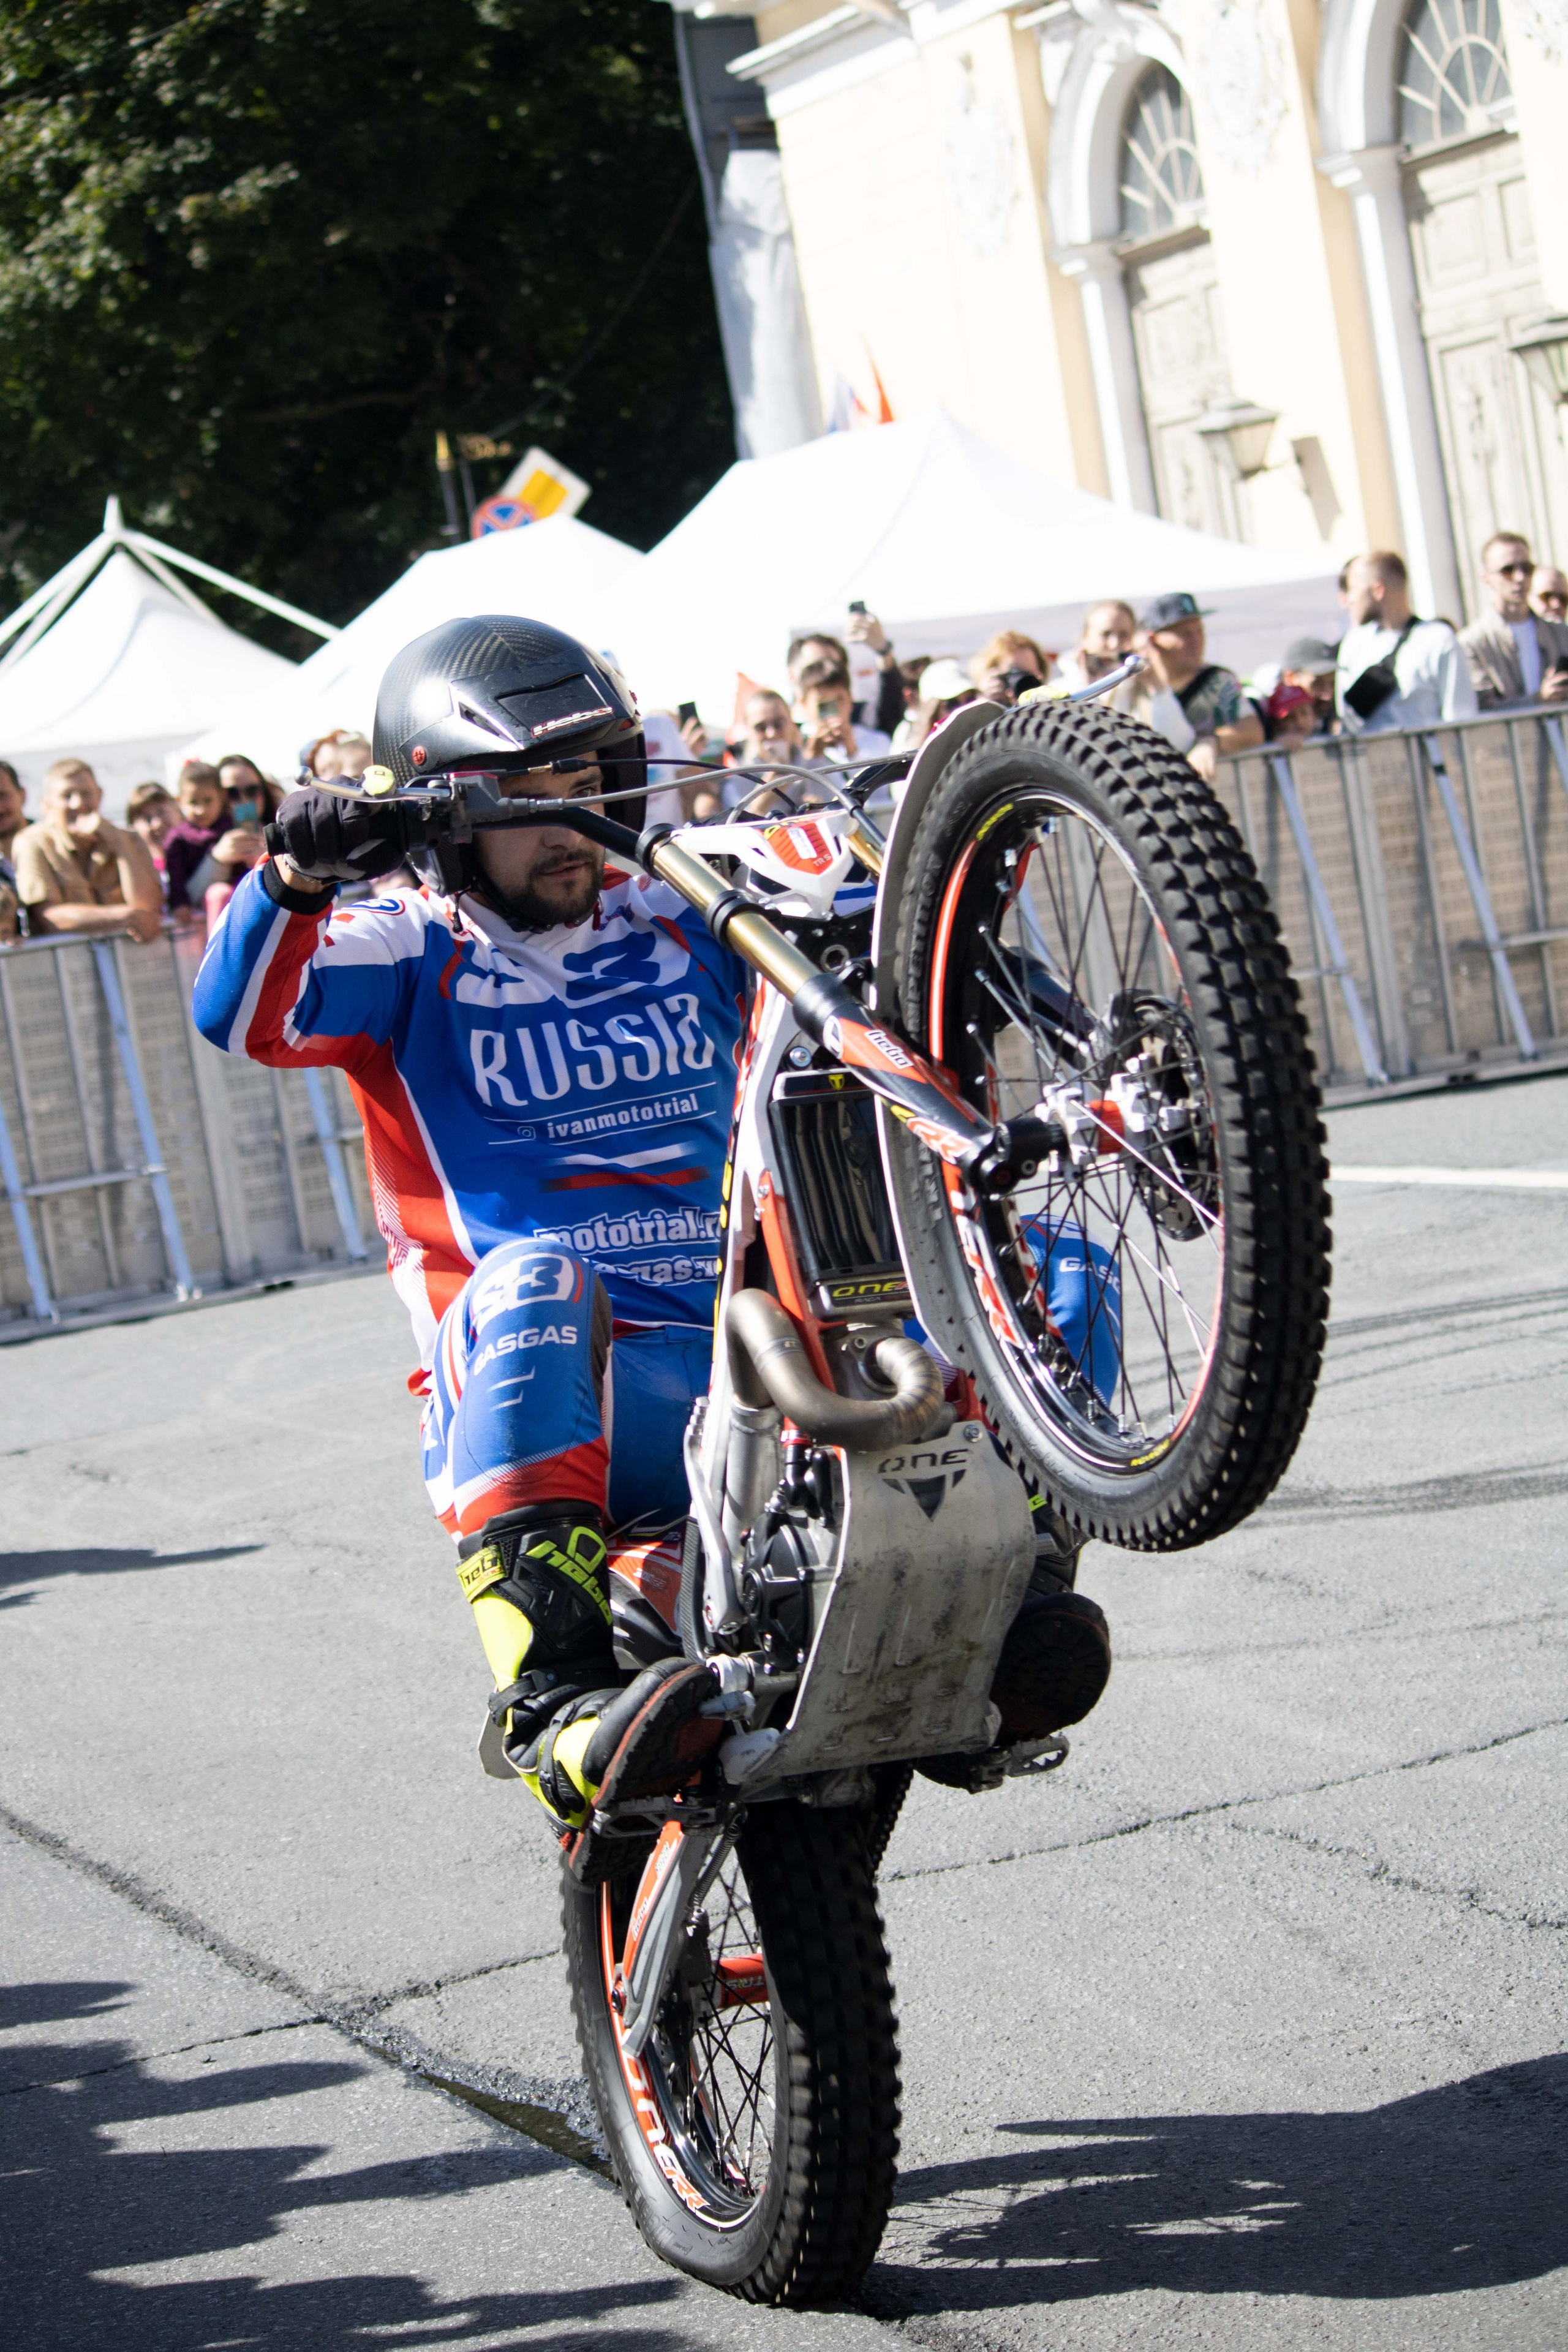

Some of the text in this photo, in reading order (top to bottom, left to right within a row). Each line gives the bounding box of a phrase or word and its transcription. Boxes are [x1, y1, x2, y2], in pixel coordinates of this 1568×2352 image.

[470, 993, 715, 1107] RUSSIA
[547, 1093, 699, 1139] ivanmototrial
[473, 1325, 578, 1376] GASGAS
